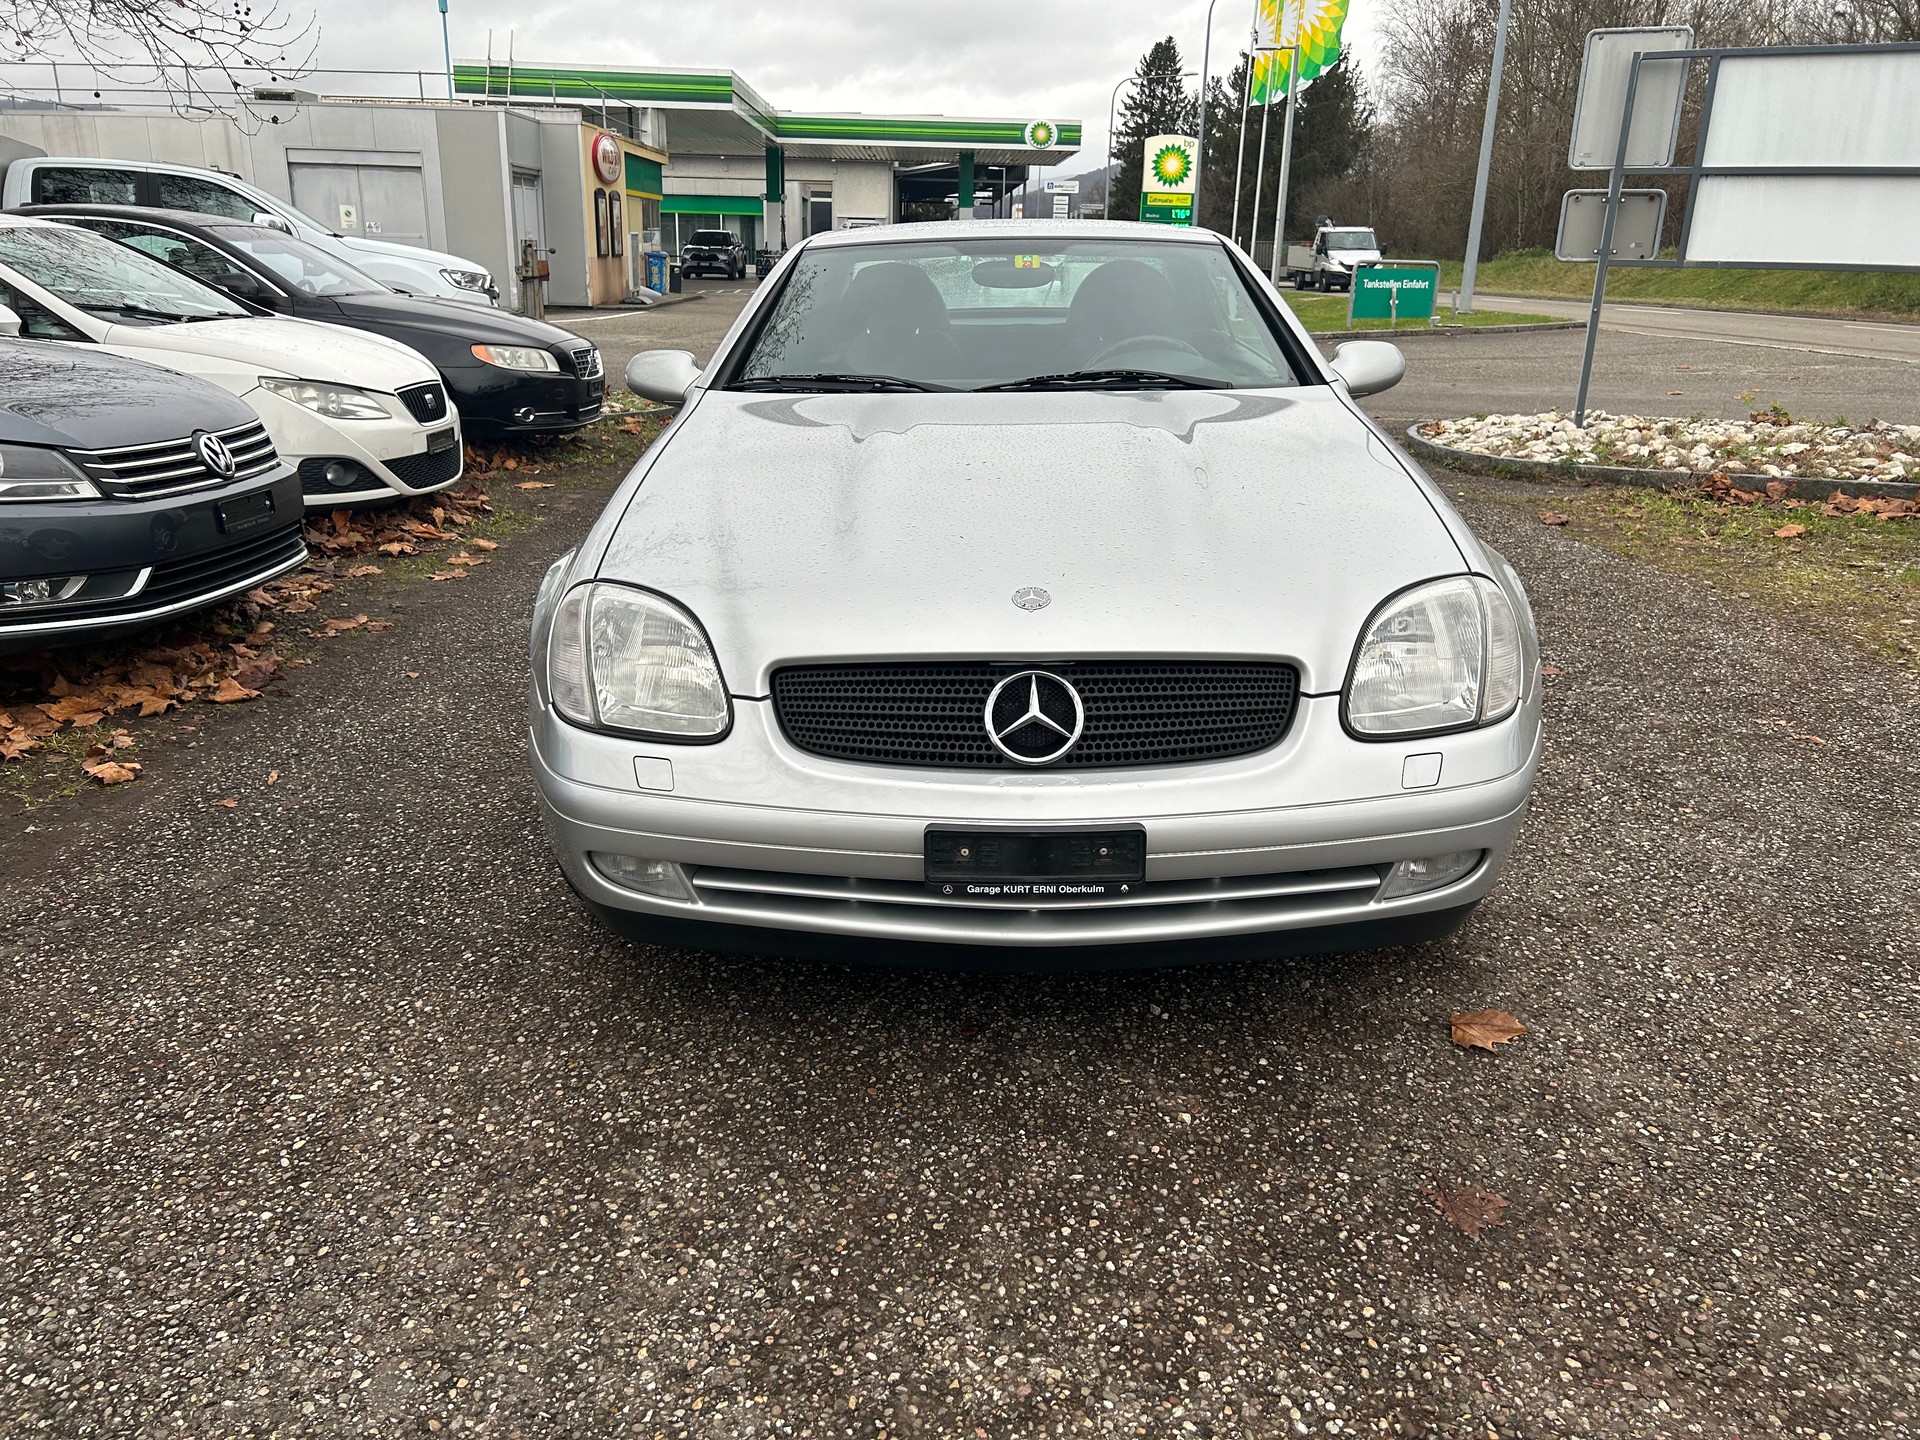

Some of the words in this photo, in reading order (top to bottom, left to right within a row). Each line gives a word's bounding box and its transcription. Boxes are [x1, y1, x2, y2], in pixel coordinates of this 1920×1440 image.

[1183, 139, 1195, 149] bp
[1363, 279, 1402, 289] Tankstellen
[1402, 279, 1429, 289] Einfahrt
[967, 884, 1001, 895] Garage
[1003, 885, 1031, 894] KURT
[1033, 885, 1057, 894] ERNI
[1059, 884, 1105, 894] Oberkulm
